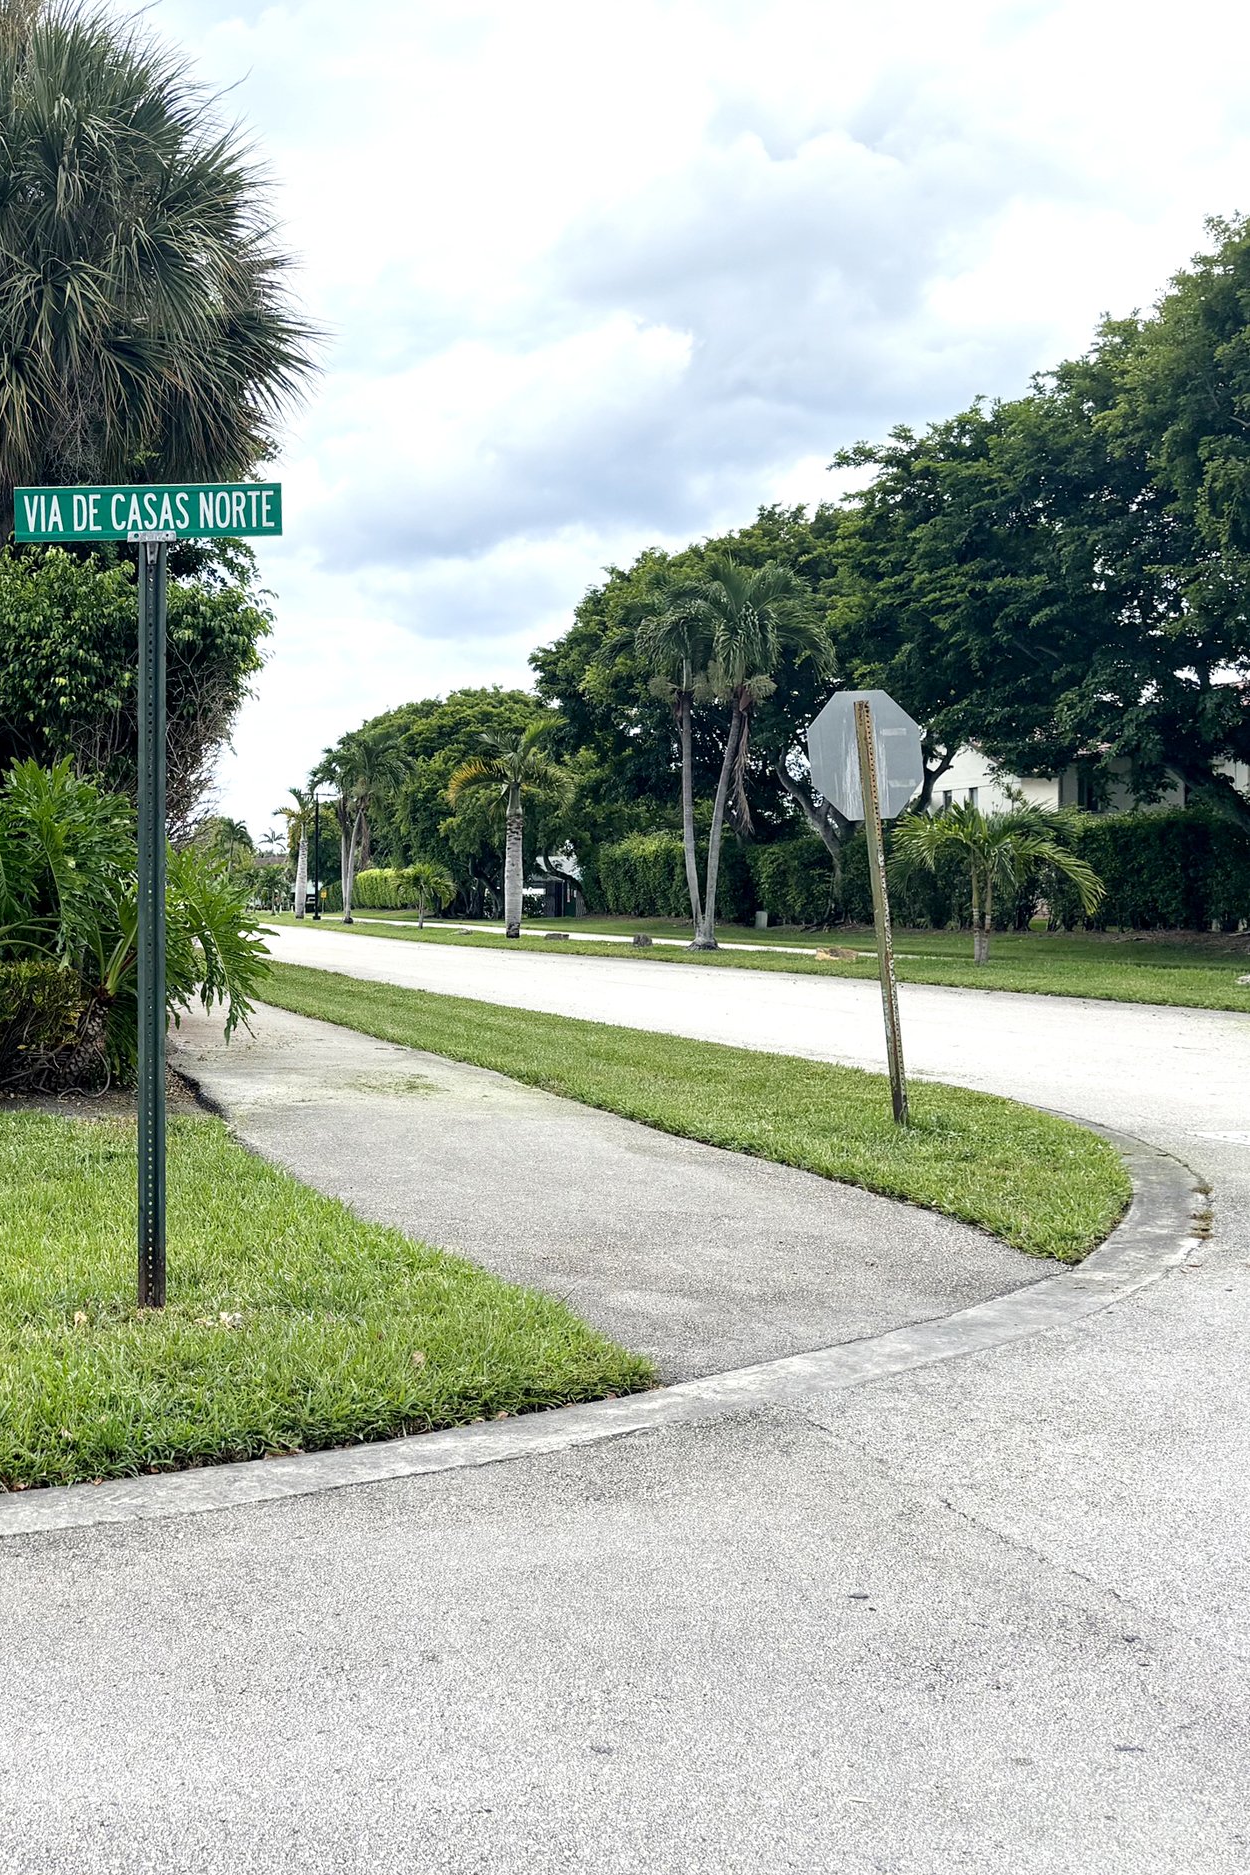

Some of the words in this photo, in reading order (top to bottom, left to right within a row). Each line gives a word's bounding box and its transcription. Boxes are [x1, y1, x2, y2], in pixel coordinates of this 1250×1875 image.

[23, 494, 64, 532] VIA
[72, 494, 102, 531] DE
[110, 492, 190, 530] CASAS
[199, 490, 275, 528] NORTE
